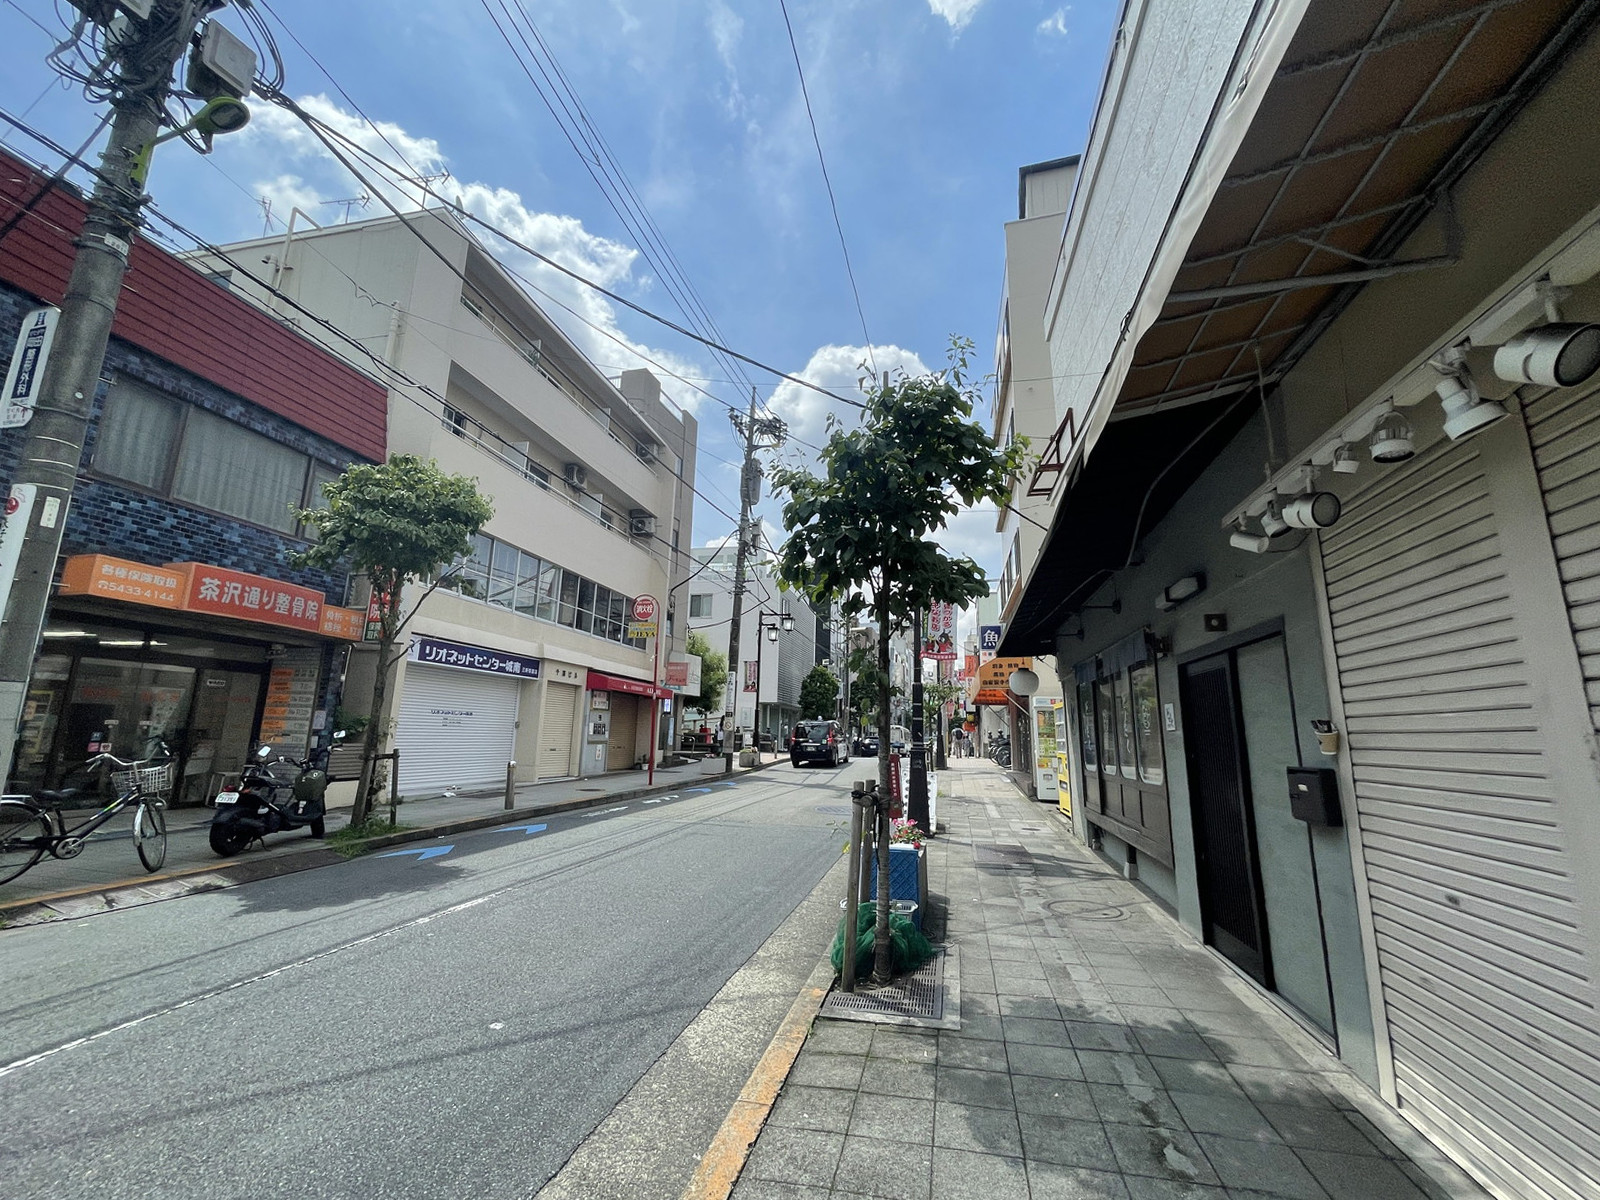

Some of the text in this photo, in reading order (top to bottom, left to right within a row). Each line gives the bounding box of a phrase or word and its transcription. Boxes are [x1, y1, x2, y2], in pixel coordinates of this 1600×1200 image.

[101, 564, 177, 588] 各種保険取扱
[198, 577, 319, 621] 茶沢通り整骨院
[636, 604, 653, 614] 消火栓
[983, 630, 998, 646] 魚
[425, 645, 521, 674] リオネットセンター城南
